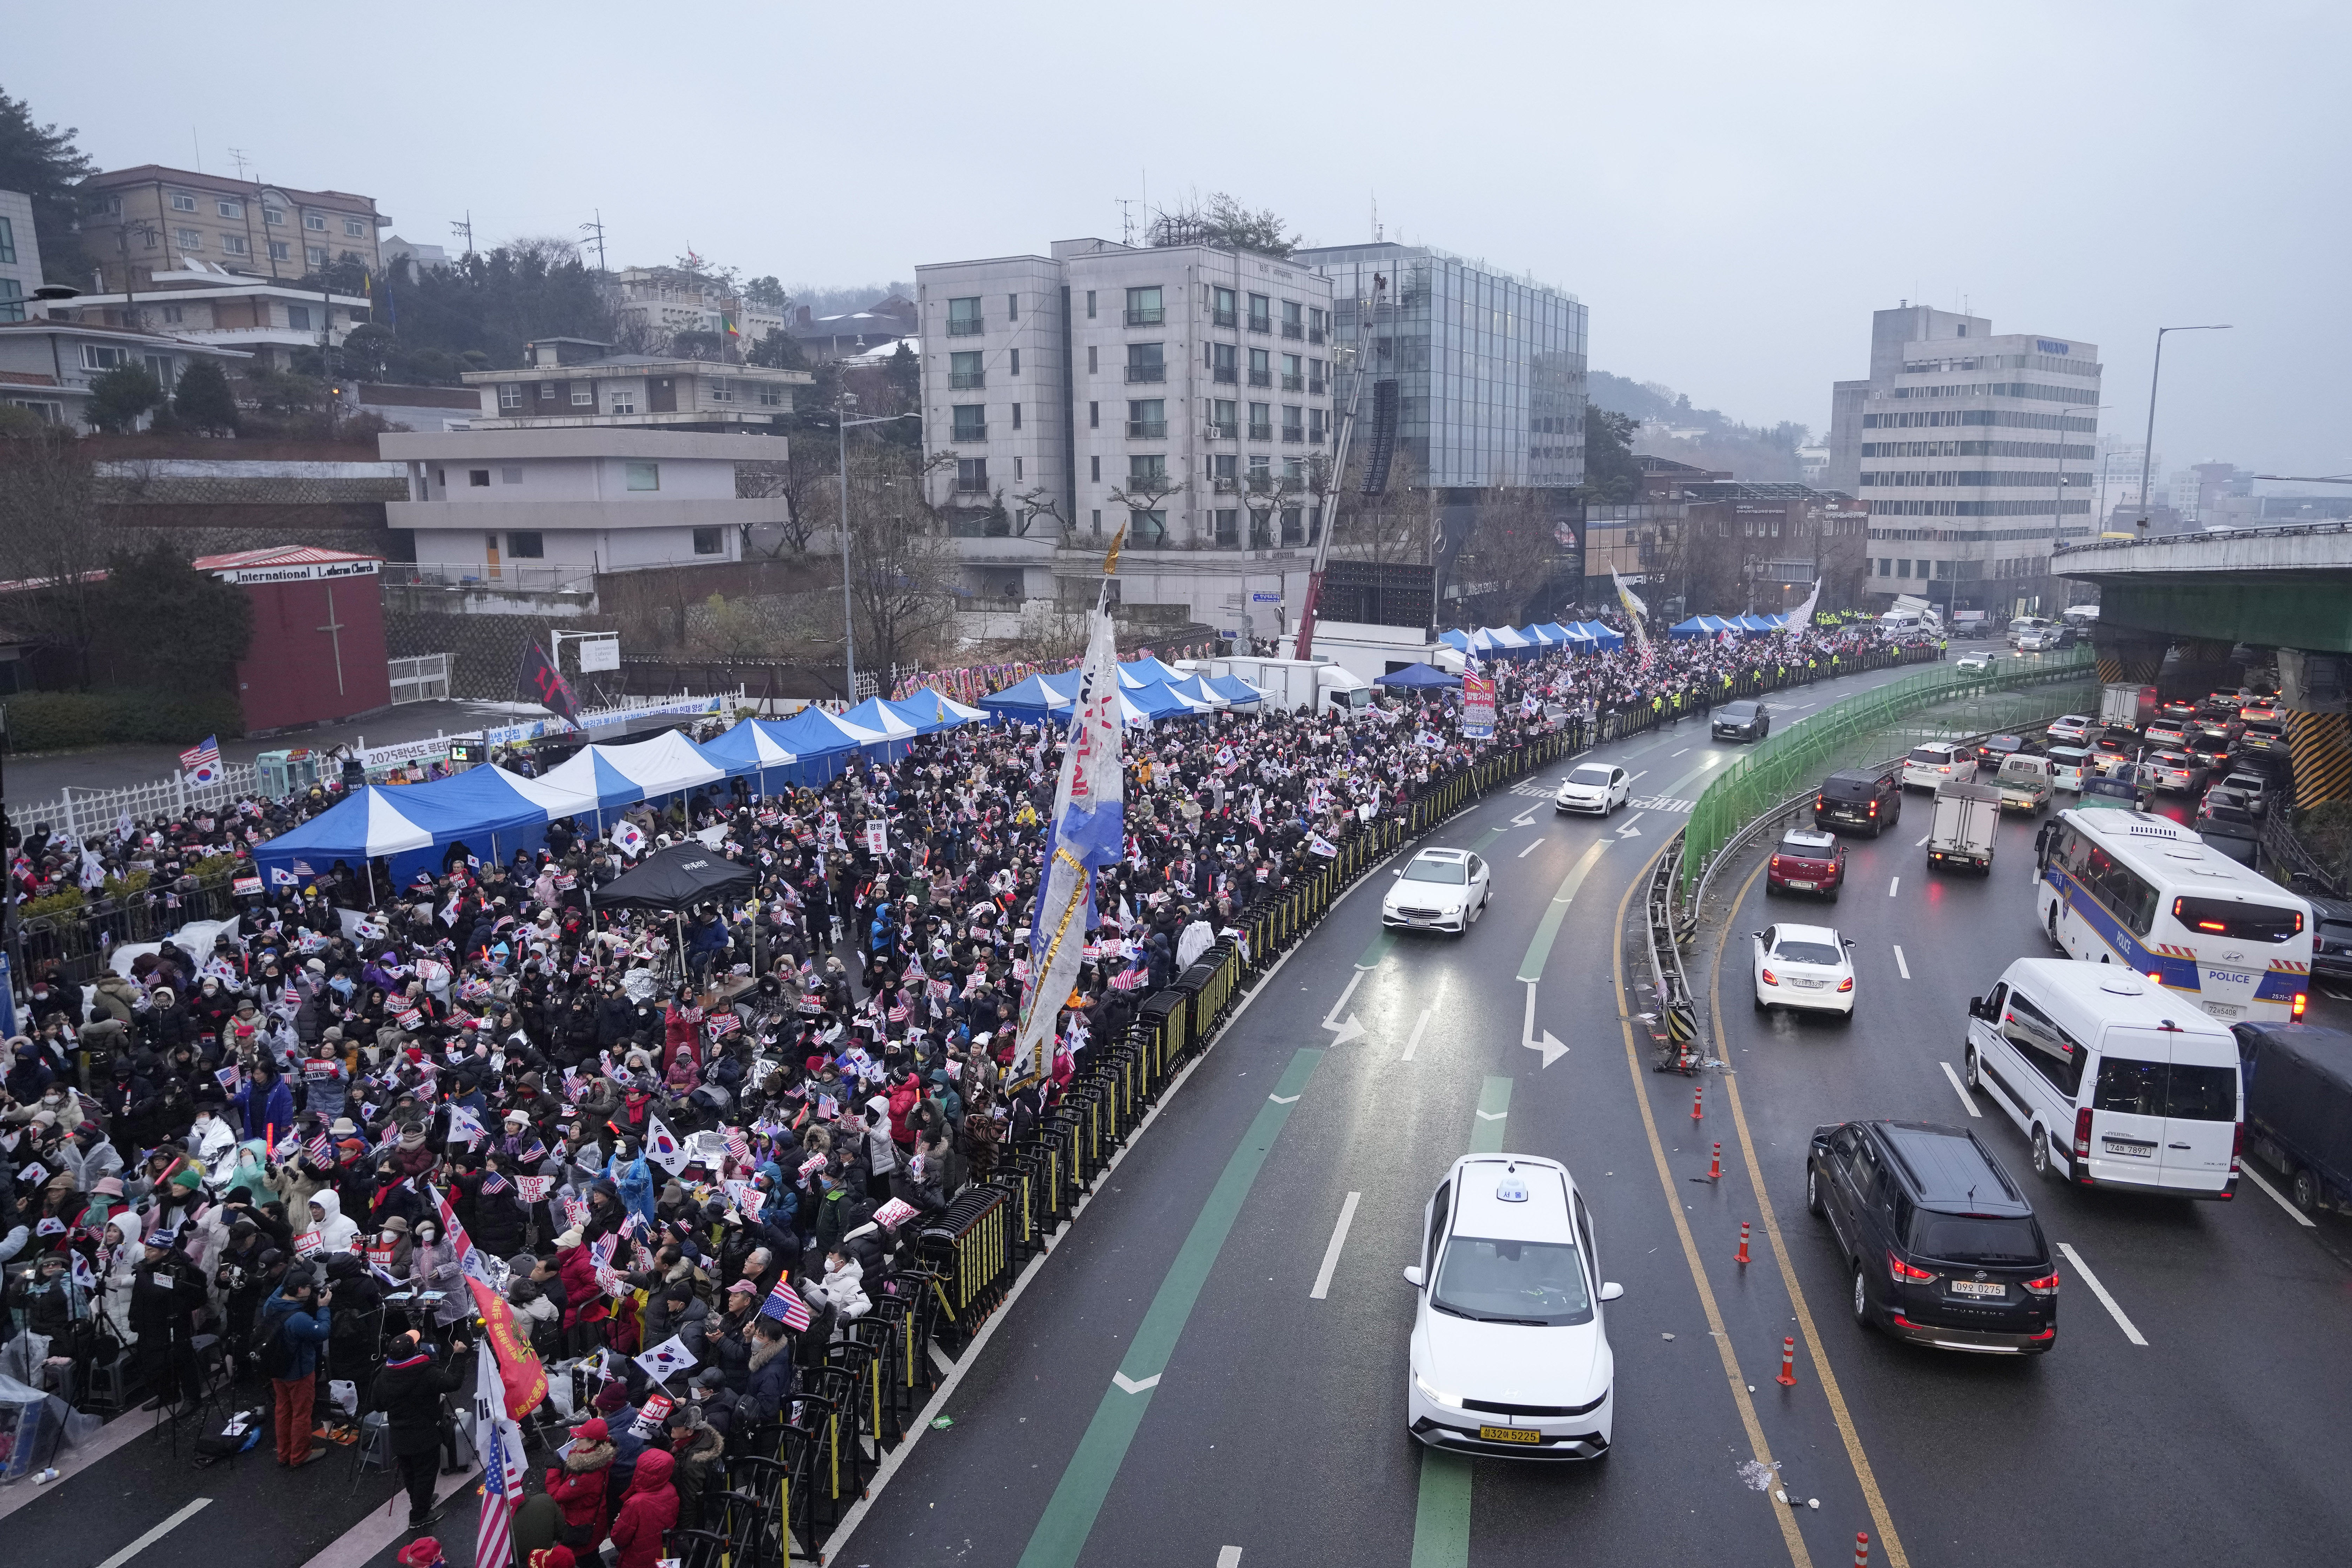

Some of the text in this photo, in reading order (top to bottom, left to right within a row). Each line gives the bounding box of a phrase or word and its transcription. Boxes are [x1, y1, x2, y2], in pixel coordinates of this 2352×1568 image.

[1274, 268, 1292, 279] OFFICETEL
[2037, 339, 2069, 355] VOLVO
[236, 561, 374, 582] International Lutheran Church
[680, 706, 691, 714] 인재
[478, 732, 502, 746] 입생
[504, 729, 520, 742] 모집
[235, 877, 261, 888] 탄핵반대
[449, 873, 463, 882] 정선거
[555, 875, 574, 883] 탄핵반대
[2116, 930, 2131, 955] POLICE
[2209, 971, 2250, 984] POLICE
[930, 981, 948, 990] STOP
[933, 986, 944, 995] THE
[802, 995, 819, 1003] 정선거
[799, 1005, 820, 1014] 가짜국회
[398, 1008, 421, 1023] 핵반대
[306, 1063, 336, 1071] 탄핵반대
[841, 1066, 851, 1074] OP
[841, 1114, 860, 1122] STOP
[2105, 1130, 2134, 1138] HYUNDAI
[2128, 1146, 2148, 1155] 7897
[814, 1153, 826, 1165] OP
[519, 1177, 544, 1187] STOP
[523, 1185, 541, 1194] THE
[742, 1190, 761, 1202] STOP
[744, 1199, 756, 1210] THE
[891, 1200, 915, 1216] STOP
[887, 1207, 908, 1220] THE
[295, 1232, 320, 1251] 반대
[351, 1248, 391, 1263] 탄반대
[602, 1274, 616, 1286] THE
[1956, 1282, 2001, 1295] 09오 0275
[1952, 1309, 2005, 1317] TURISMO
[641, 1400, 671, 1419] 반대
[1491, 1429, 1509, 1439] 32아
[1511, 1432, 1536, 1441] 5225
